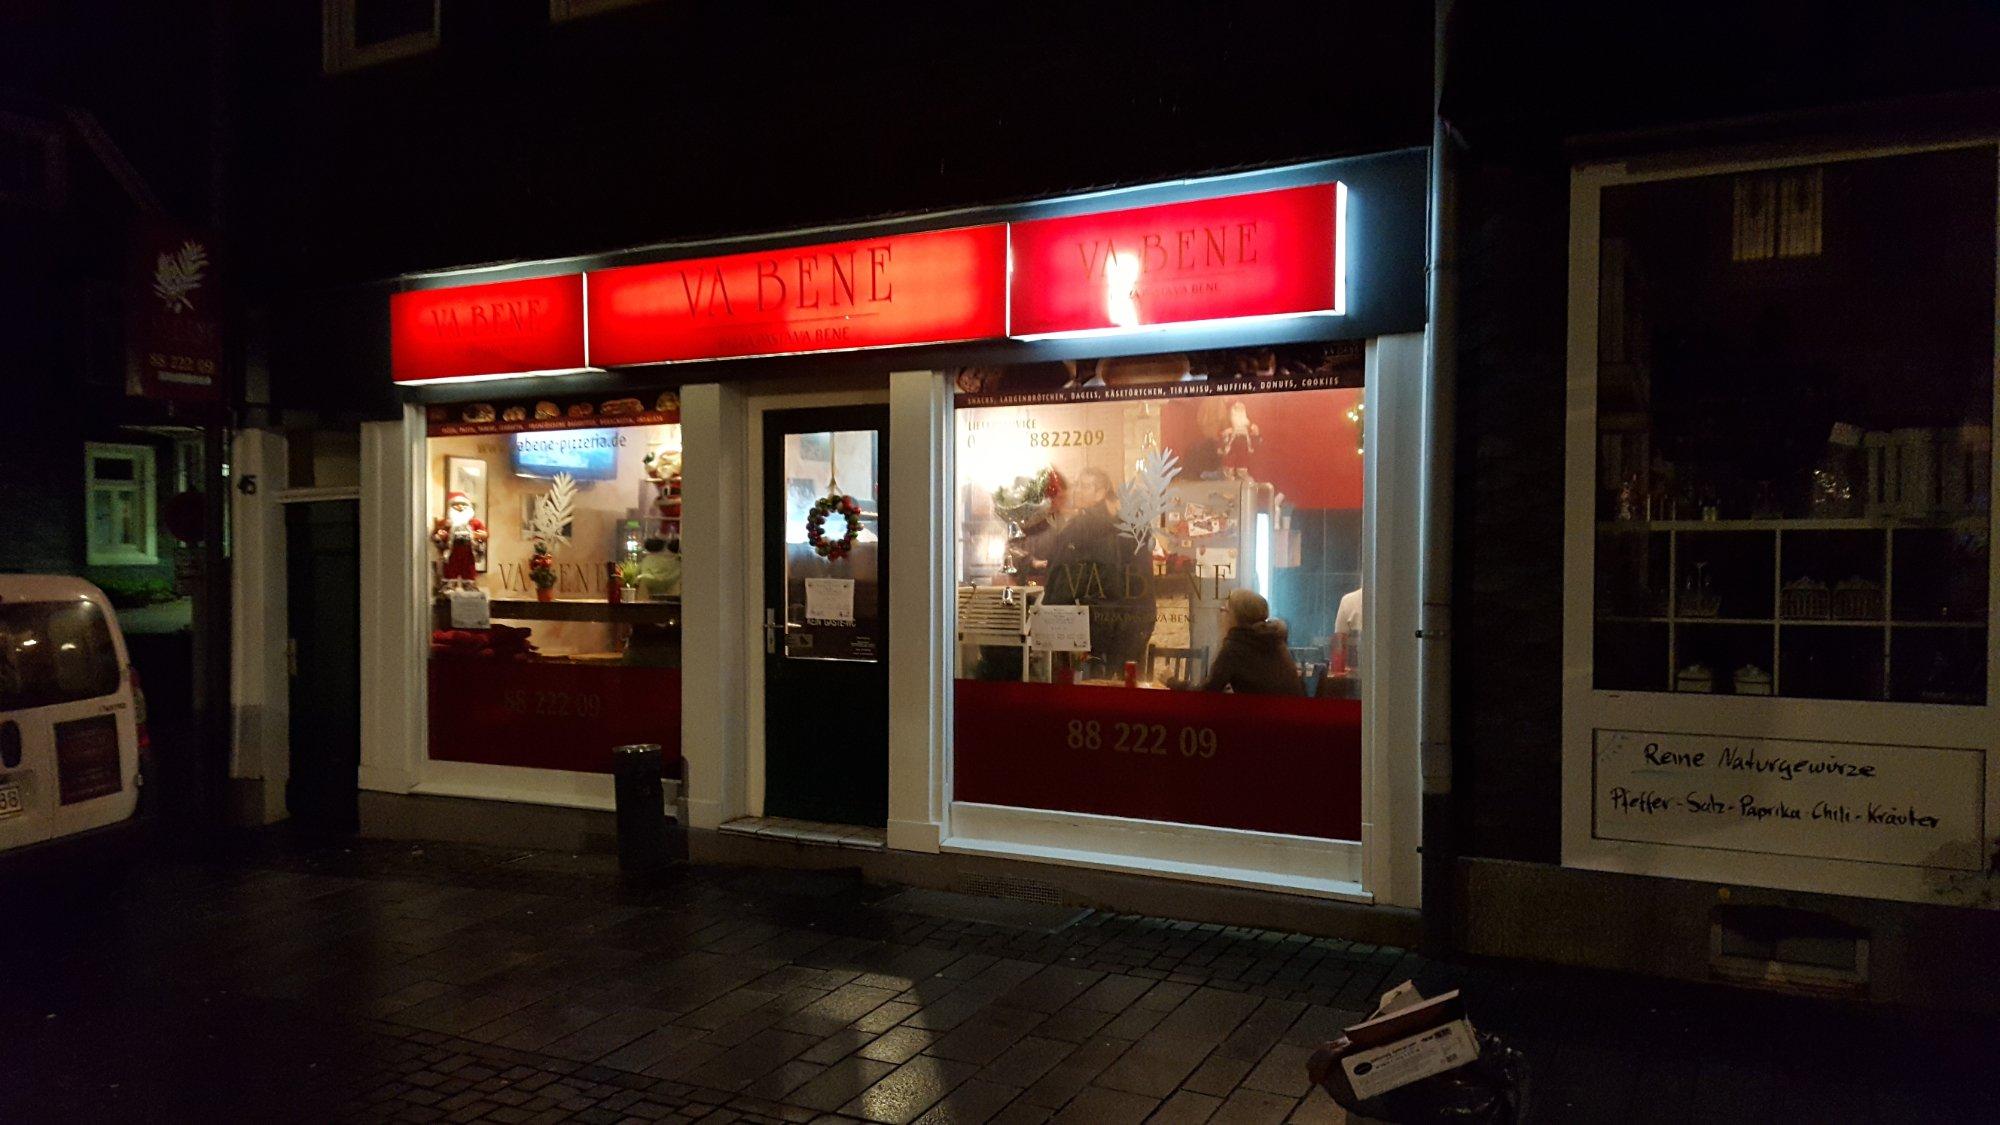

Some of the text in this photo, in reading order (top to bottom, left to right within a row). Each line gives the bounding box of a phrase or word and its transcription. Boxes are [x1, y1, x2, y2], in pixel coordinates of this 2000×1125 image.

[1079, 221, 1257, 280] VA BENE
[679, 243, 892, 318] VA BENE
[470, 299, 541, 336] BENE
[815, 326, 849, 340] BENE
[1070, 390, 1101, 400] BAGELS,
[1105, 385, 1166, 398] KÄSETÖRTCHEN,
[1170, 384, 1212, 395] TIRAMISU,
[1216, 381, 1256, 392] MUFFINS,
[1260, 379, 1297, 390] DONUTS,
[1301, 376, 1340, 387] COOKIES
[1030, 429, 1105, 448] 8822209
[498, 562, 528, 592] VA
[1063, 562, 1106, 599] VA
[1067, 719, 1218, 758] 88 222 09
[1643, 743, 1704, 767] Reine
[1740, 794, 1802, 820] Paprika
[1811, 800, 1850, 823] Chili
